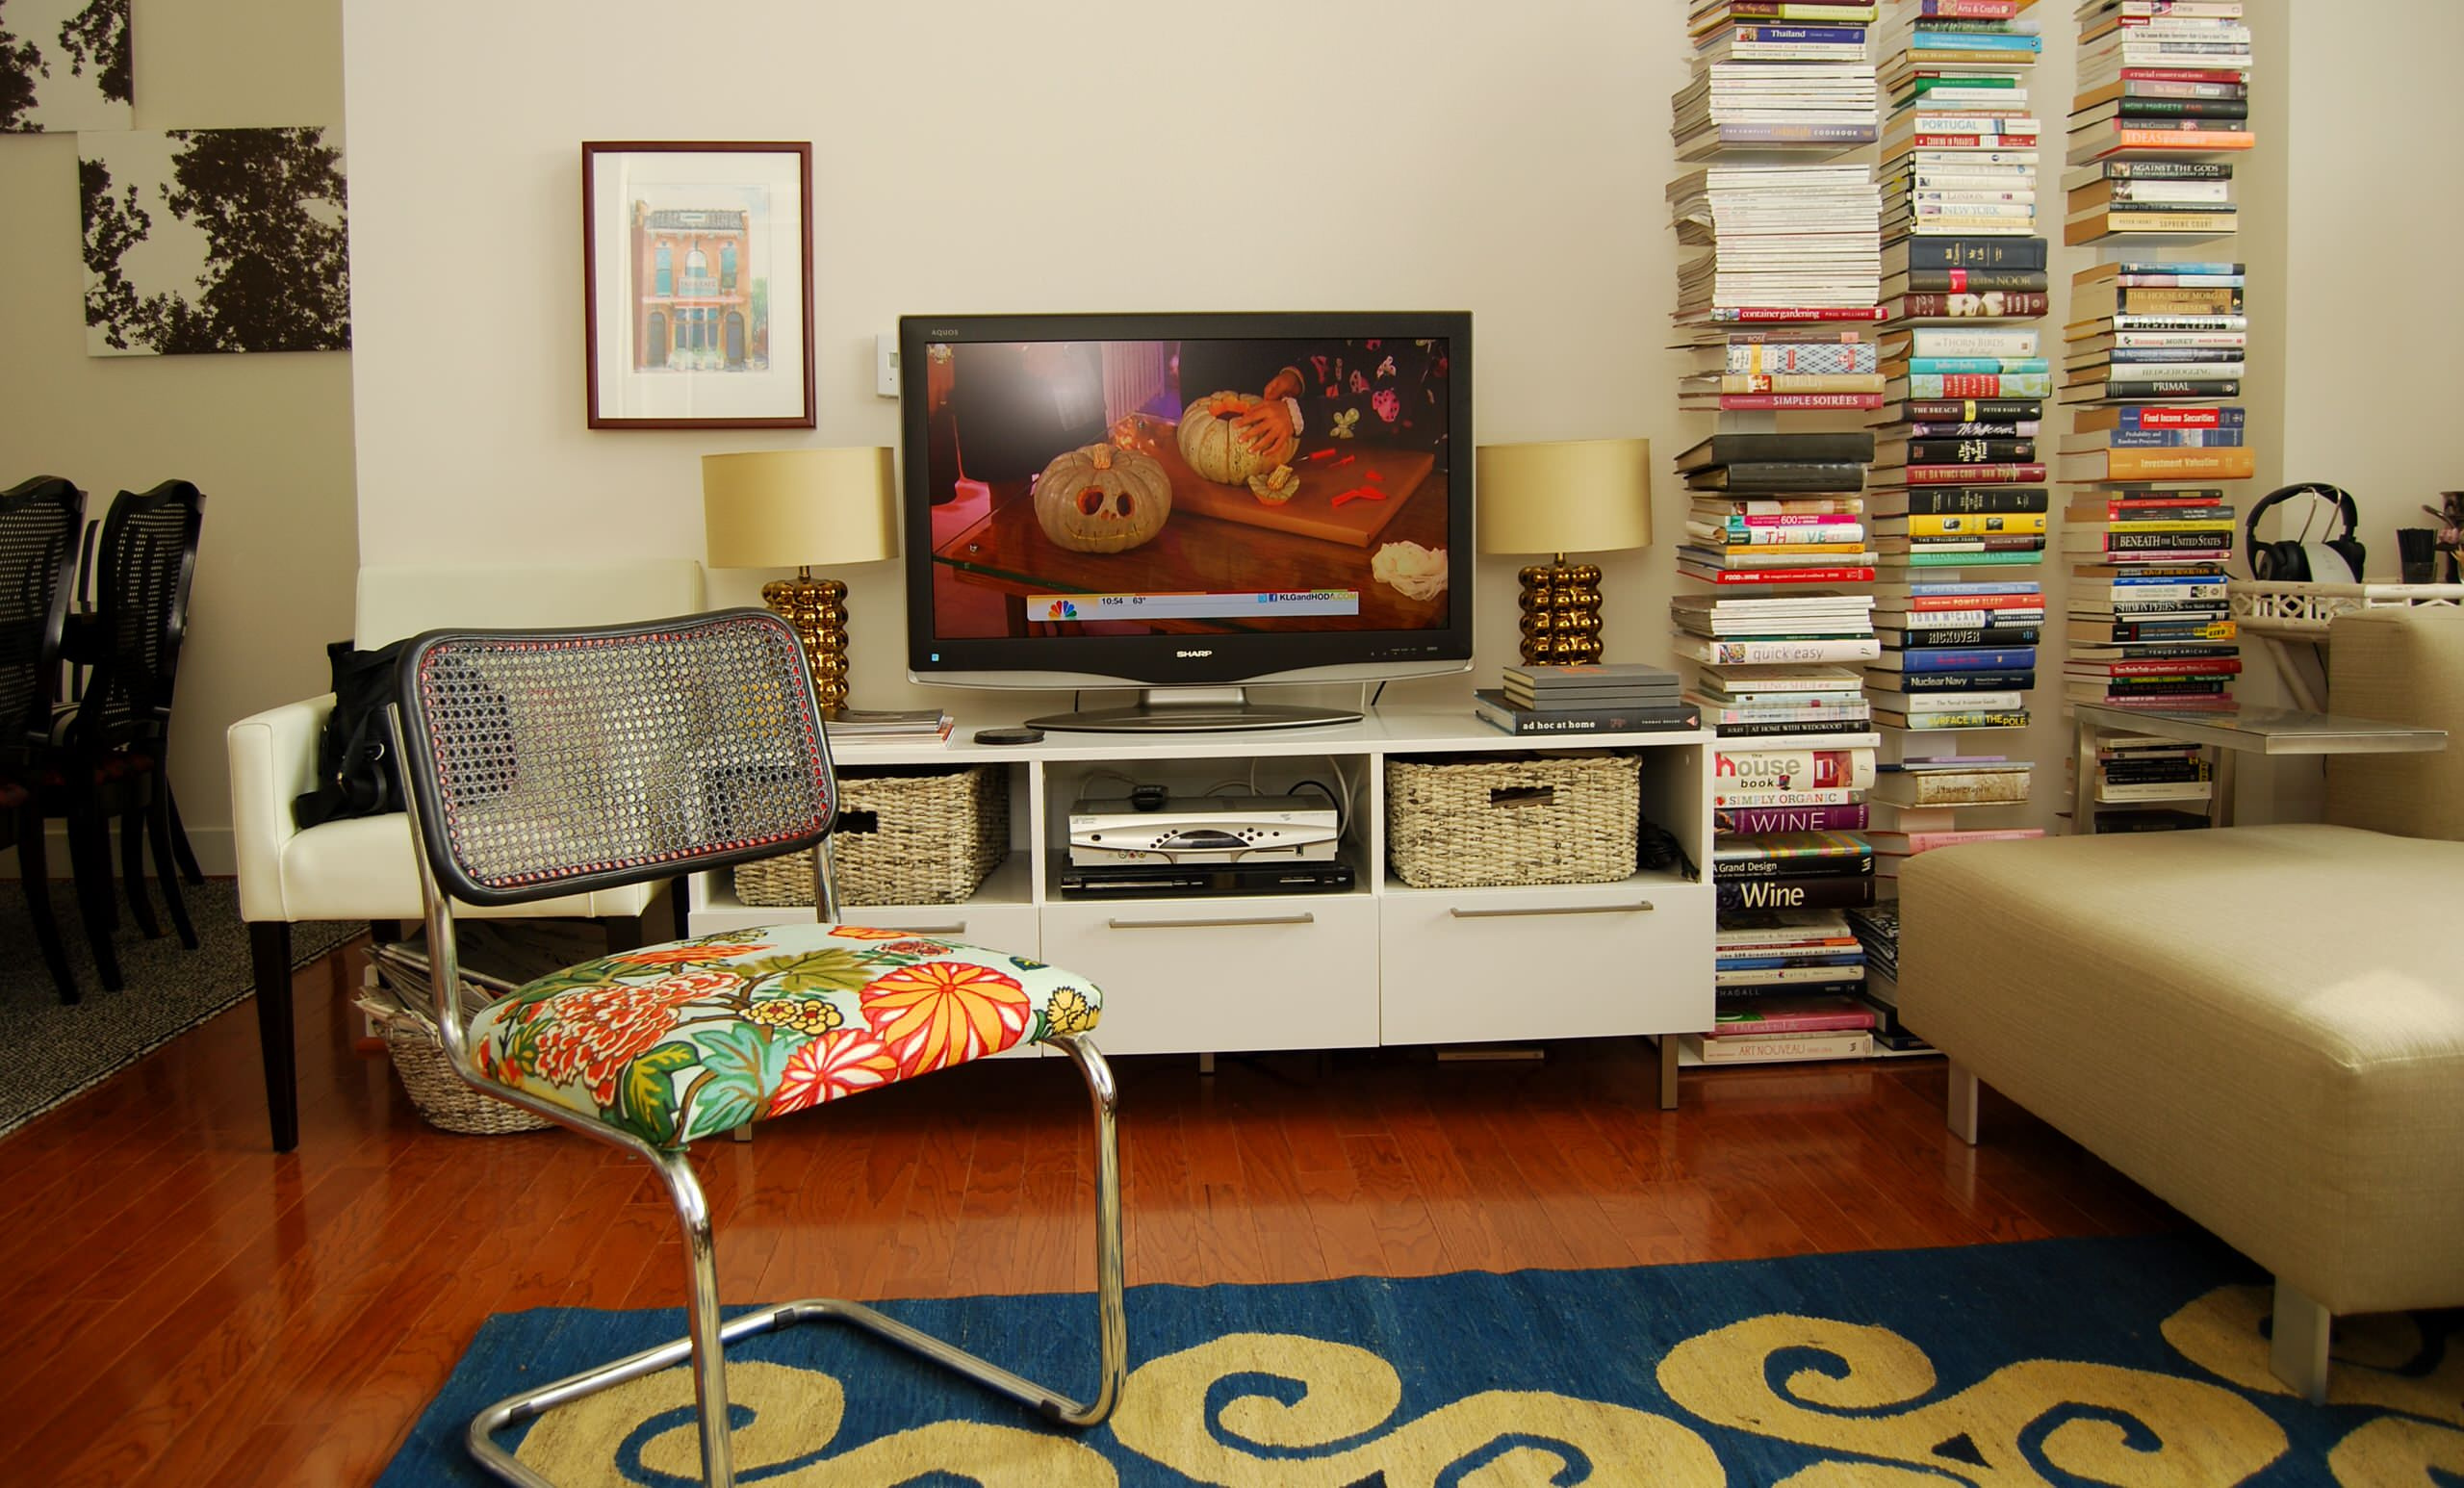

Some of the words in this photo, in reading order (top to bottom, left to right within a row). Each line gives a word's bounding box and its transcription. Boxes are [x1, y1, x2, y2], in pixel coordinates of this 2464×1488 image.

[1980, 5, 2001, 13] Crafts
[1921, 119, 1979, 130] PORTUGAL
[2125, 132, 2164, 143] IDEAS
[1943, 204, 1969, 215] NEW
[1972, 204, 2000, 215] YORK
[1996, 275, 2031, 285] NOOR
[2129, 292, 2146, 300] THE
[2148, 292, 2176, 300] HOUSE
[2178, 292, 2190, 300] OF
[2192, 292, 2230, 300] MORGAN
[1742, 310, 1781, 319] container
[1781, 309, 1820, 320] gardening
[1943, 338, 1975, 348] THORN
[1978, 338, 2005, 347] BIRDS
[2143, 368, 2211, 376] HEDGEHOGGING
[2152, 382, 2190, 392] PRIMAL
[1773, 396, 1810, 406] SIMPLE
[1812, 394, 1859, 405] SOIRÉES
[2161, 414, 2182, 423] Income
[2183, 414, 2216, 423] Securities
[2141, 458, 2182, 468] Investment
[2185, 458, 2219, 467] Valuation
[1913, 470, 1927, 479] THE
[1929, 470, 1938, 478] DA
[1939, 470, 1958, 478] VINCI
[1960, 469, 1976, 478] CODE
[1781, 516, 1798, 525] 600
[2120, 535, 2160, 548] BENEATH
[2171, 535, 2197, 547] UNITED
[2198, 535, 2221, 547] STATES
[1101, 597, 1123, 605] 10:54
[1279, 592, 1357, 602] KLGandHODA.COM
[1911, 612, 1938, 623] JOHN
[1928, 630, 1980, 644] RICKOVER
[1753, 647, 1789, 662] quick
[1794, 647, 1824, 660] easy
[1911, 678, 1944, 686] Nuclear
[1945, 677, 1967, 686] Navy
[1537, 721, 1554, 730] hoc
[1568, 720, 1596, 729] home
[1928, 715, 1968, 726] SURFACE
[1971, 715, 1983, 724] AT
[1986, 714, 2003, 724] THE
[2003, 717, 2026, 726] POLE
[1714, 752, 1801, 777] house
[1740, 778, 1775, 788] book
[1730, 795, 1775, 806] SIMPLY
[1779, 793, 1837, 804] ORGANIC
[1751, 811, 1825, 833] WINE
[1719, 862, 1745, 872] Grand
[1748, 861, 1778, 872] Design
[1740, 882, 1805, 909] Wine
[1717, 988, 1760, 997] HAGALL
[1739, 1046, 1757, 1056] ART
[1757, 1044, 1806, 1055] NOUVEAU
